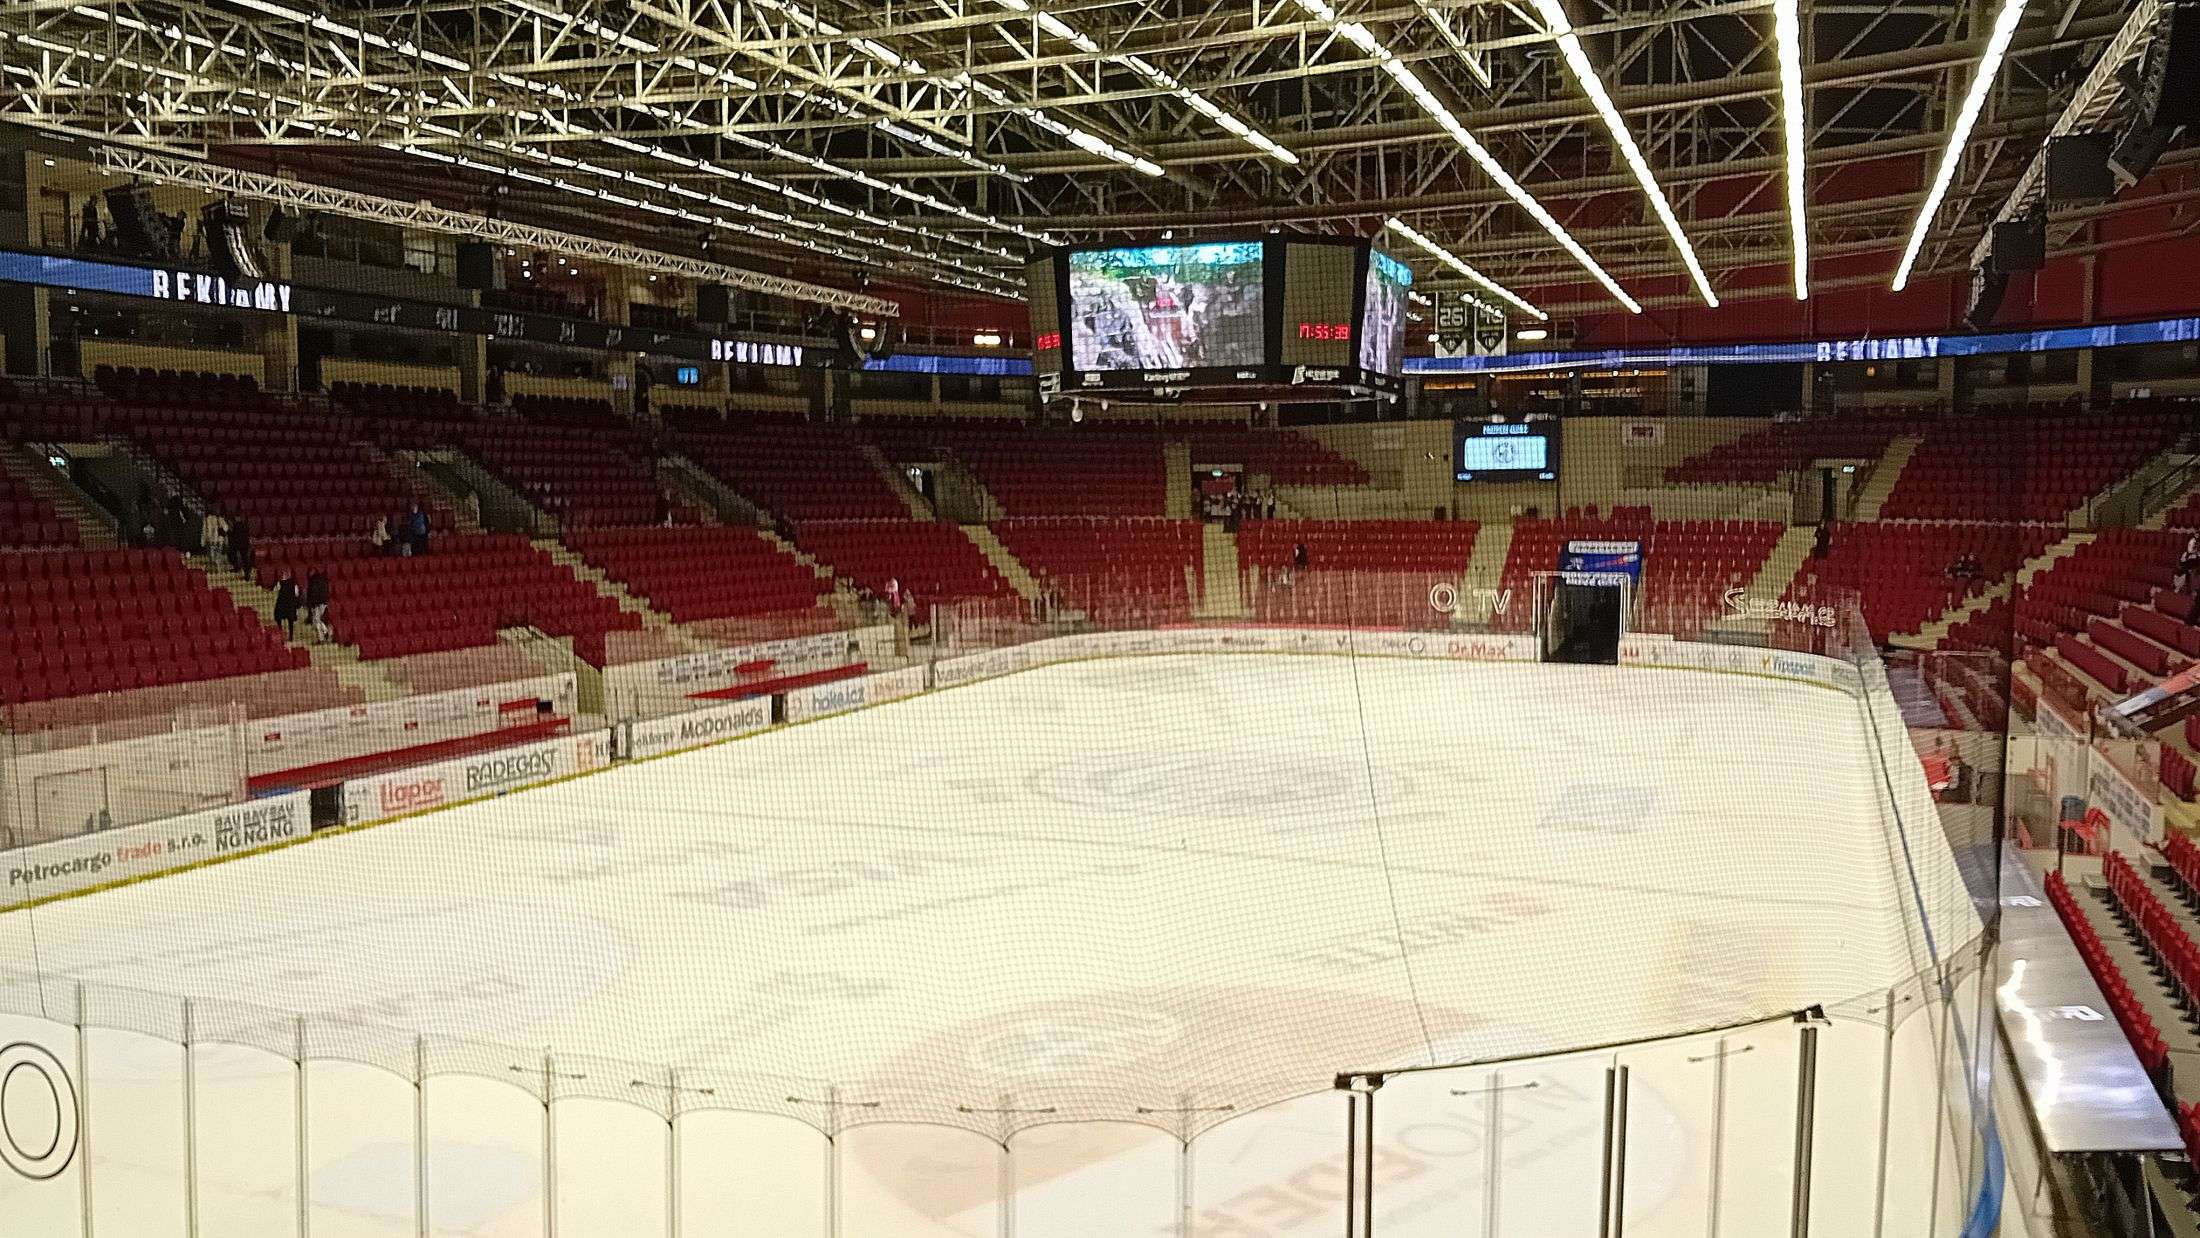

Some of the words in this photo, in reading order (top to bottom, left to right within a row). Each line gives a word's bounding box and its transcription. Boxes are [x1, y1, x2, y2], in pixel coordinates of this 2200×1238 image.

[1440, 307, 1464, 327] 26
[681, 705, 764, 740] McDonald's
[466, 748, 559, 792] RADEGAST
[9, 851, 112, 886] Petrocargo
[116, 840, 162, 862] trade
[167, 834, 207, 854] s.r.o.
